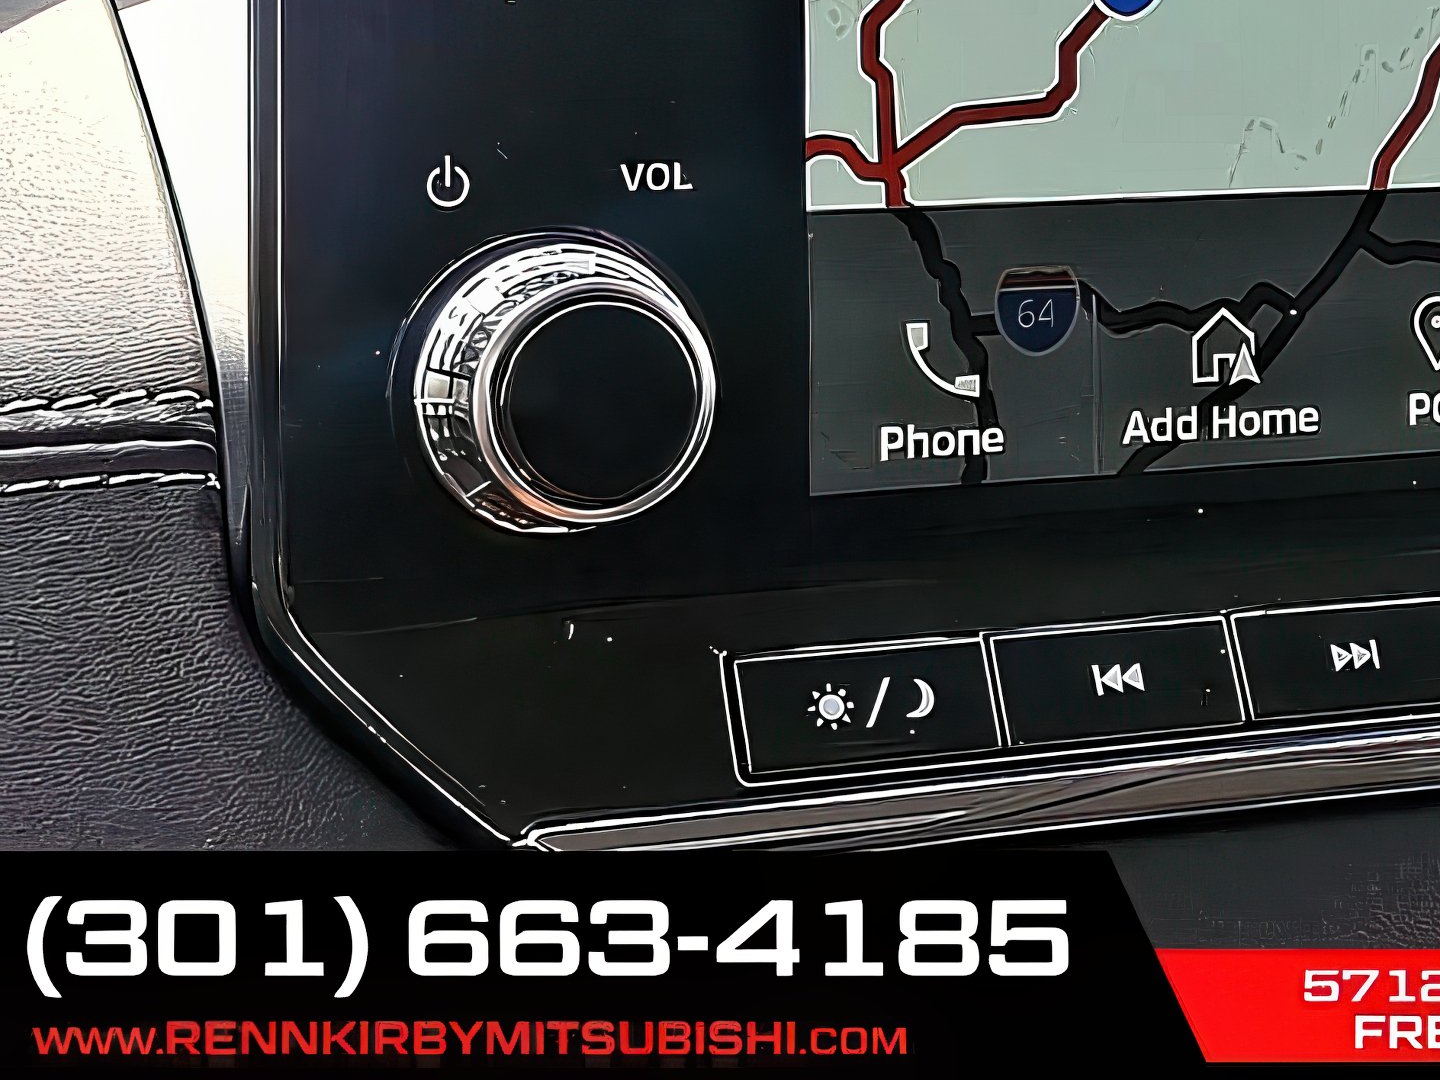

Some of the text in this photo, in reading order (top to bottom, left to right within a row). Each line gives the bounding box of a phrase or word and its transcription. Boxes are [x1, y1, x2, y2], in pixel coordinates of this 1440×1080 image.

[620, 162, 693, 191] VOL
[1017, 299, 1055, 329] 64
[1123, 406, 1318, 444] Add Home
[880, 424, 1003, 461] Phone
